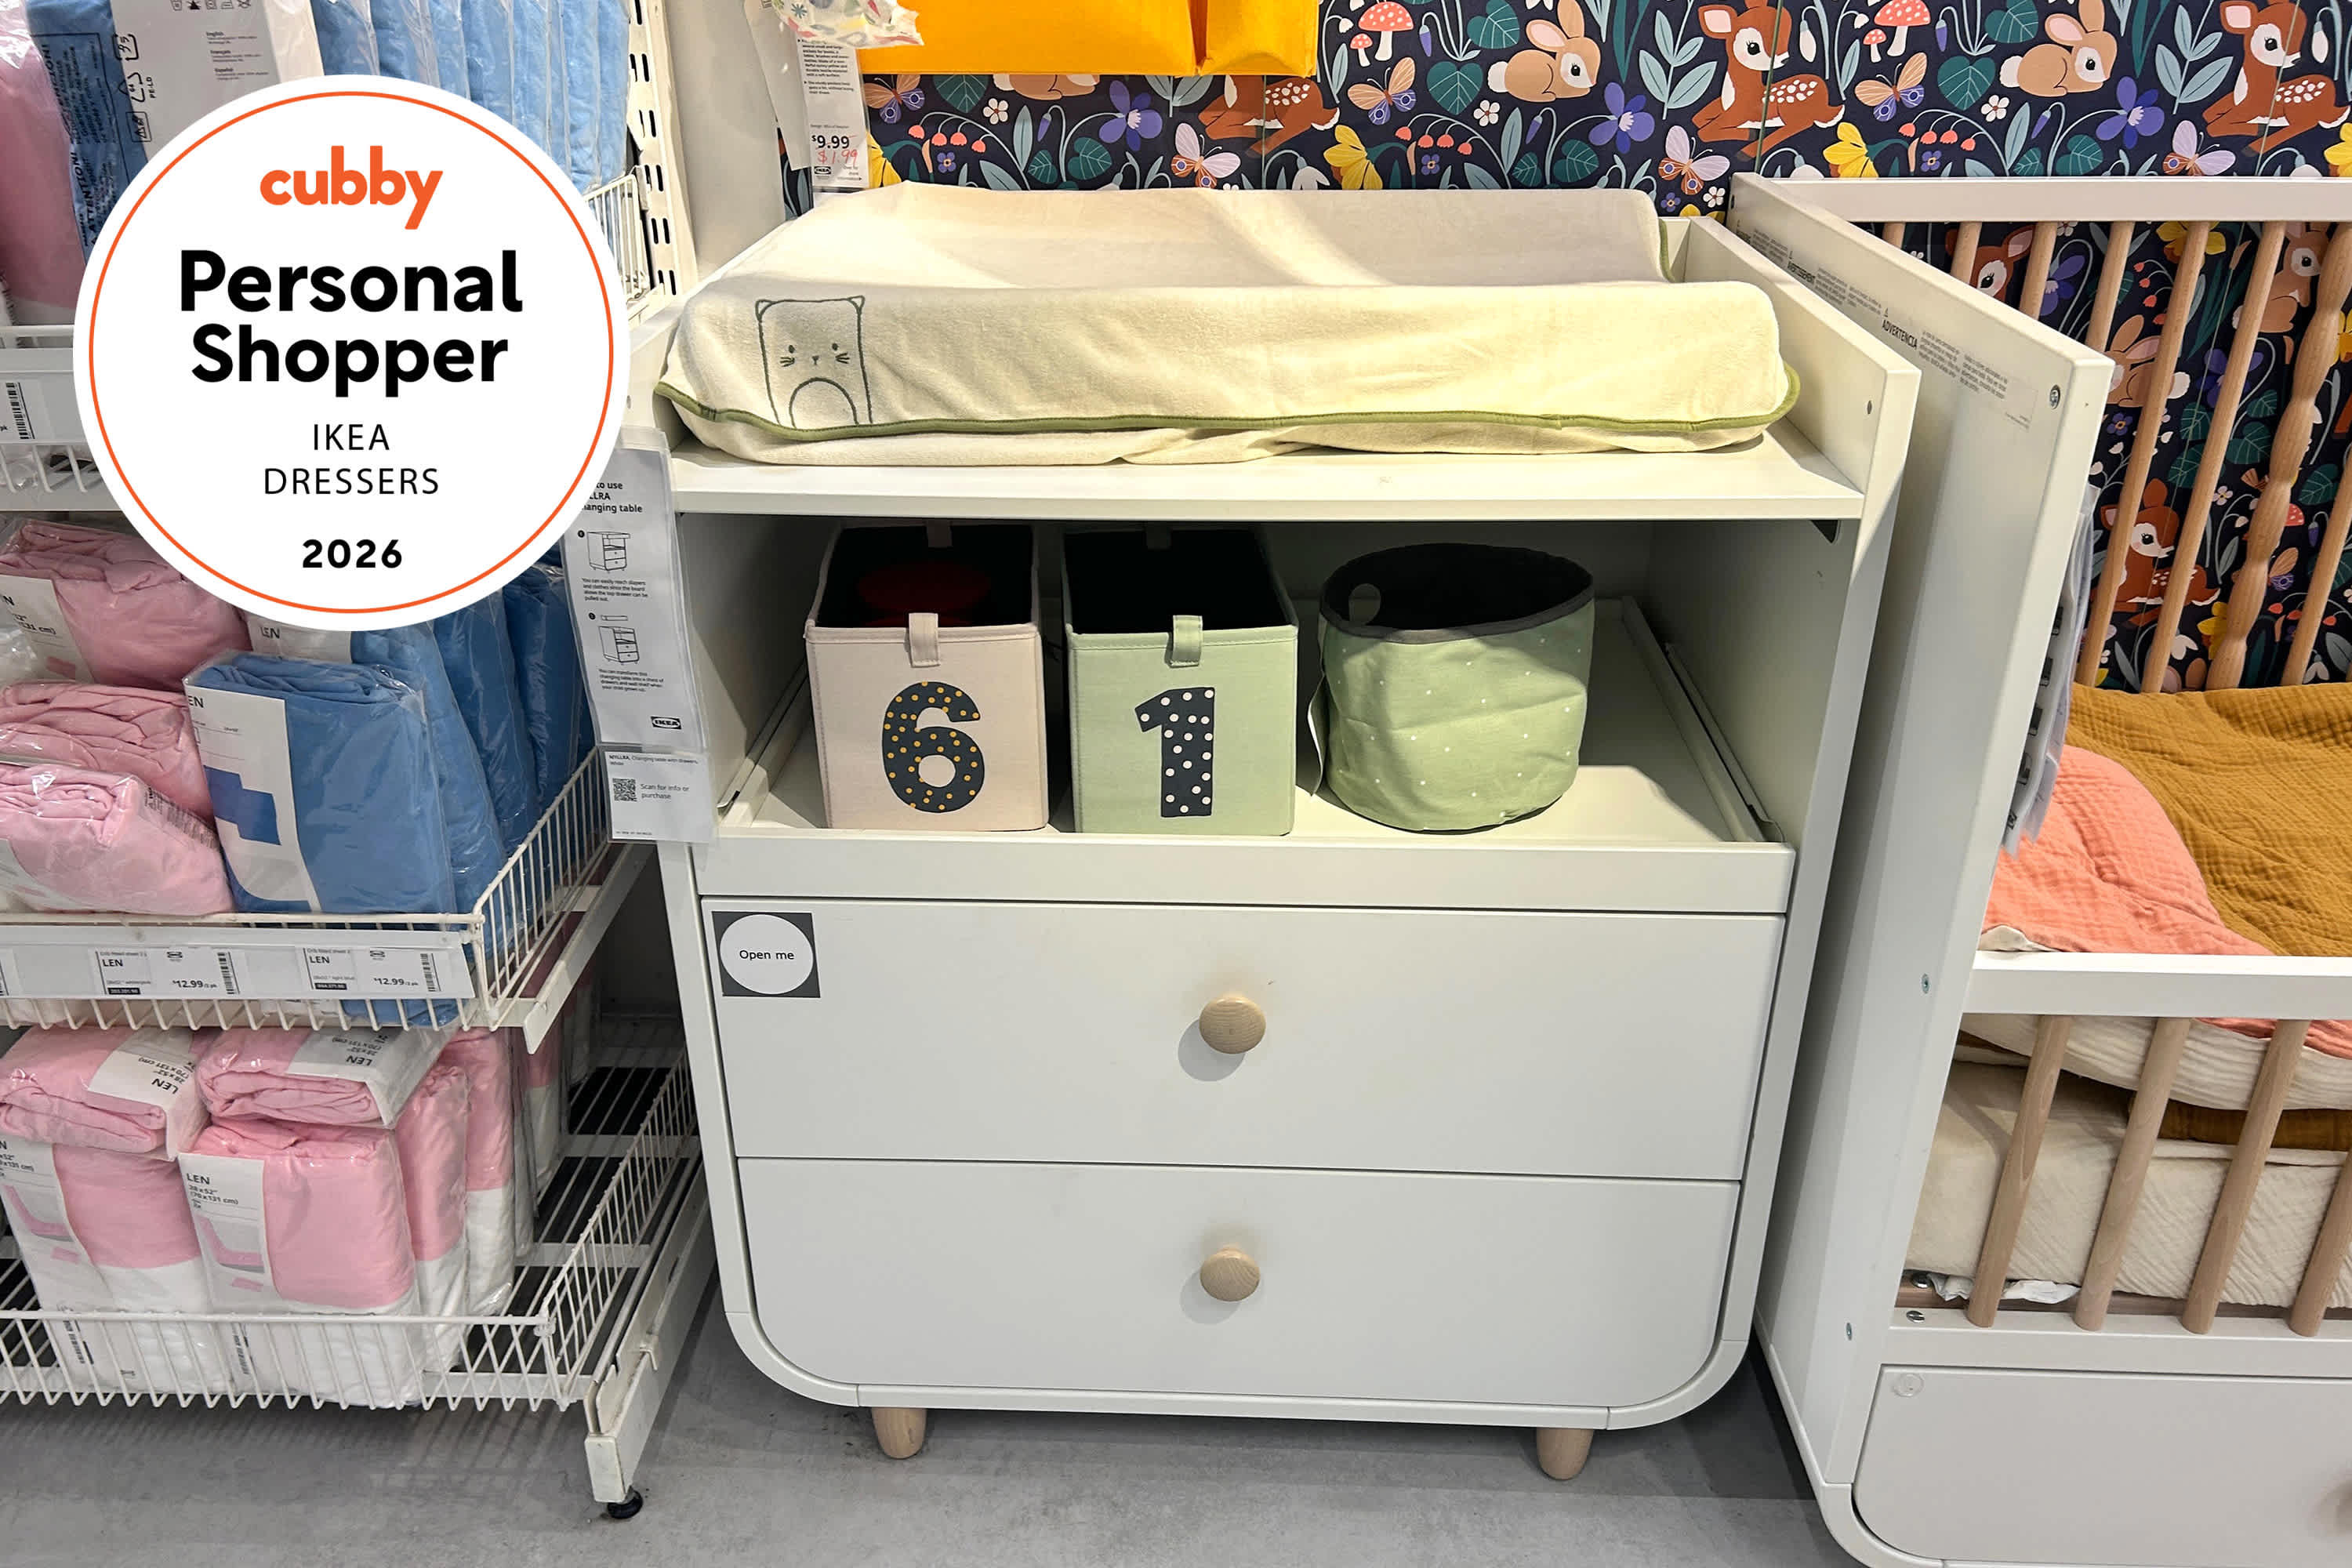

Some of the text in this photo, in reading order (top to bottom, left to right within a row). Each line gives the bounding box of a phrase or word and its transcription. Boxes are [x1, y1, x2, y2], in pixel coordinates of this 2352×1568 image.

[811, 135, 850, 149] $9.99
[817, 149, 858, 167] $1.99
[1882, 318, 1918, 350] ADVERTENCIA
[619, 504, 643, 513] table
[260, 626, 280, 639] LEN
[188, 695, 204, 708] EN
[882, 681, 985, 813] 6
[1135, 687, 1215, 817] 1
[739, 949, 771, 961] Open
[346, 1055, 372, 1065] LEN
[151, 1078, 179, 1094] LEN
[187, 1173, 210, 1185] LEN
